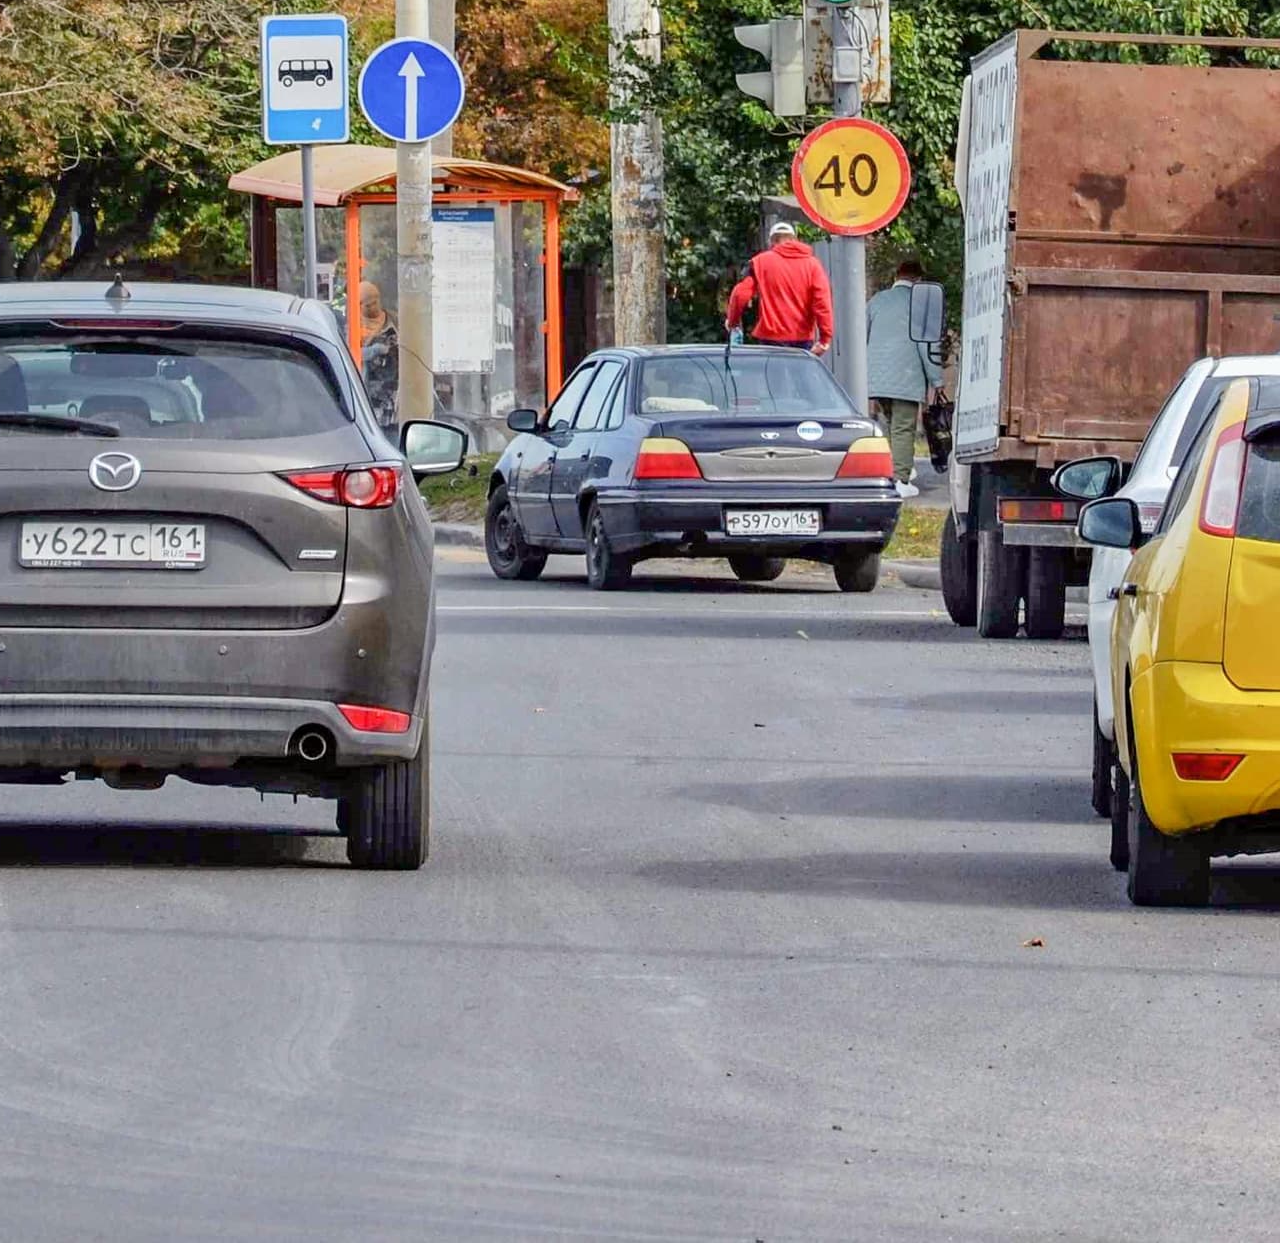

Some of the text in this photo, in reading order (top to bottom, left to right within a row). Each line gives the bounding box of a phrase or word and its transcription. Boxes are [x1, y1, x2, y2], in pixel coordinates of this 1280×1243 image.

[813, 153, 879, 197] 40
[793, 513, 816, 525] 161
[155, 527, 198, 549] 161
[160, 549, 185, 558] RUS
